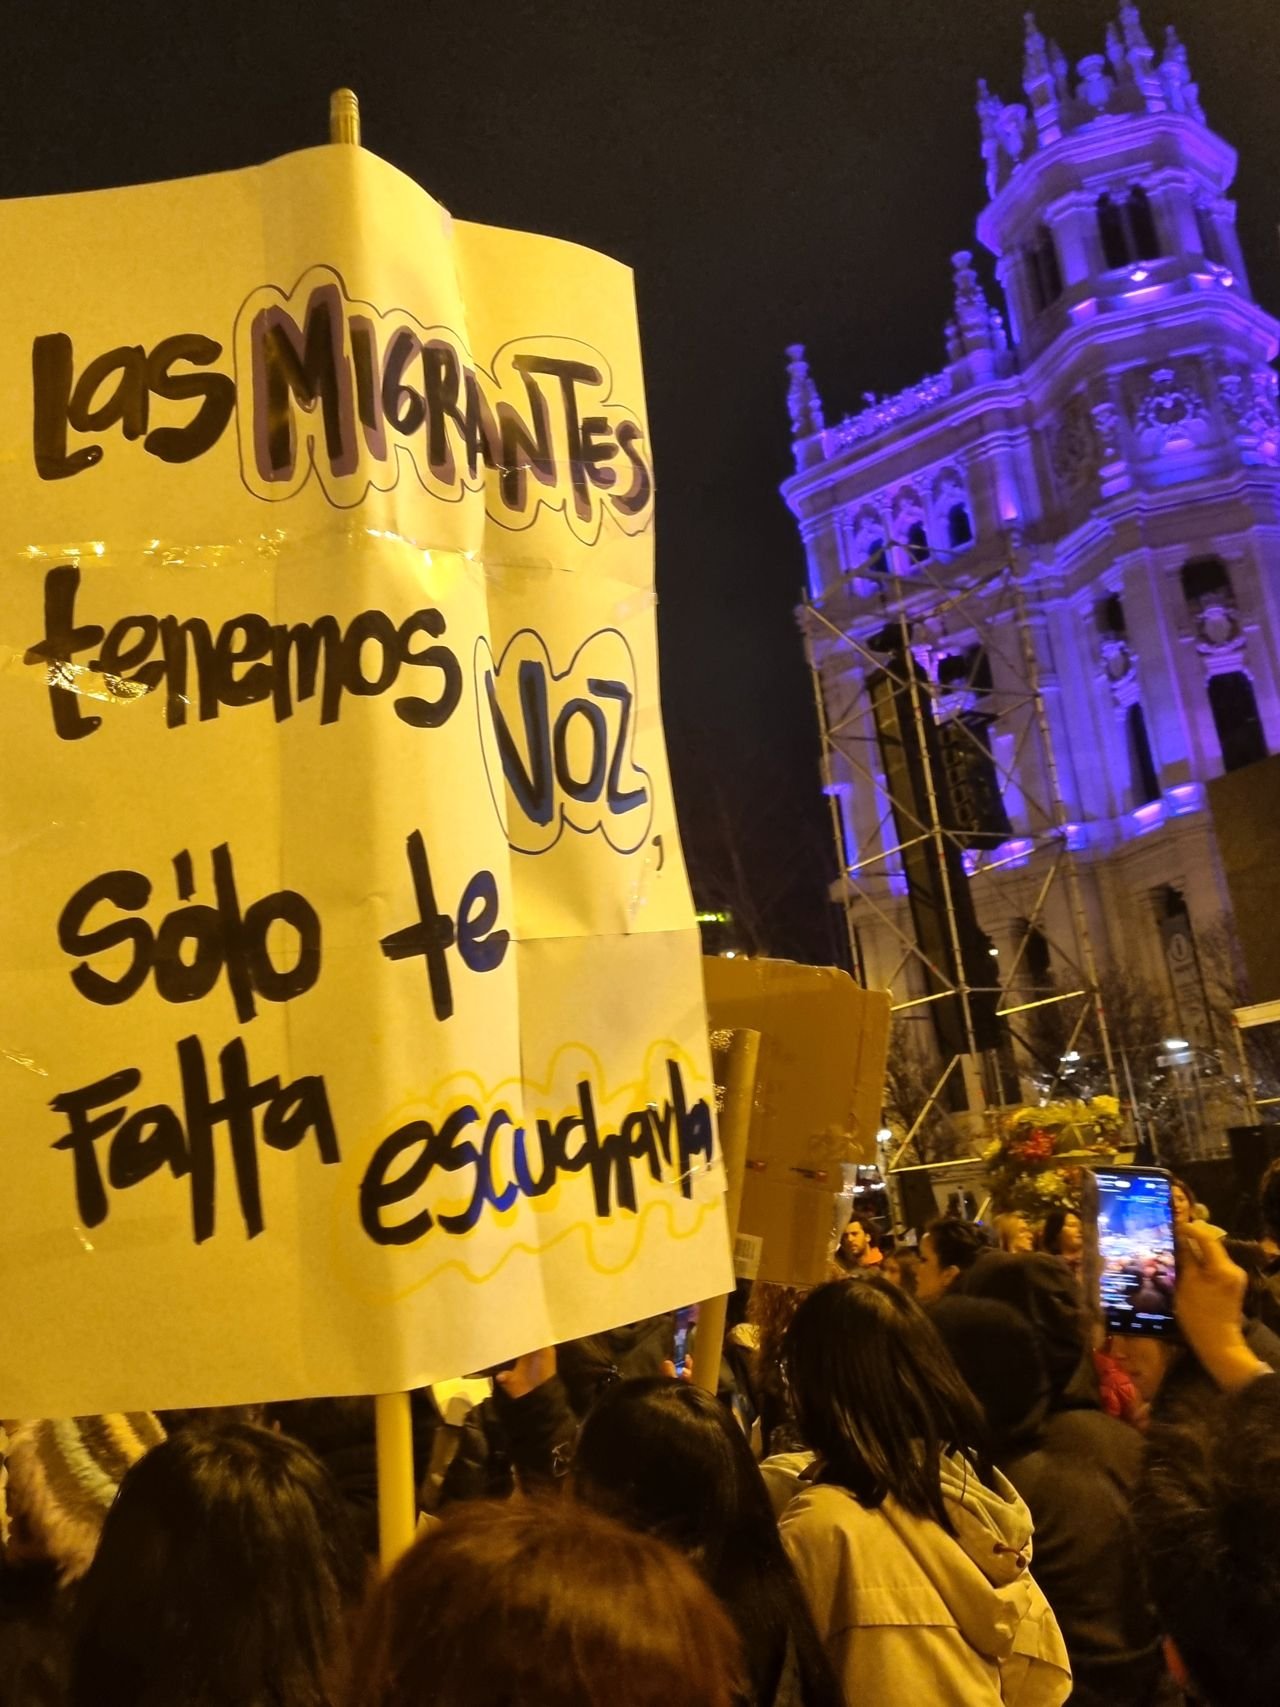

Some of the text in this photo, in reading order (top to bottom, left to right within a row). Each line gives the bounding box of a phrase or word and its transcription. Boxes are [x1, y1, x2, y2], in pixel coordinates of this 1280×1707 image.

[32, 283, 652, 523] Las MIGRANTES
[24, 566, 463, 740] tenemos
[58, 829, 511, 1024] Sólo te
[46, 1034, 713, 1246] Falta escucharla
